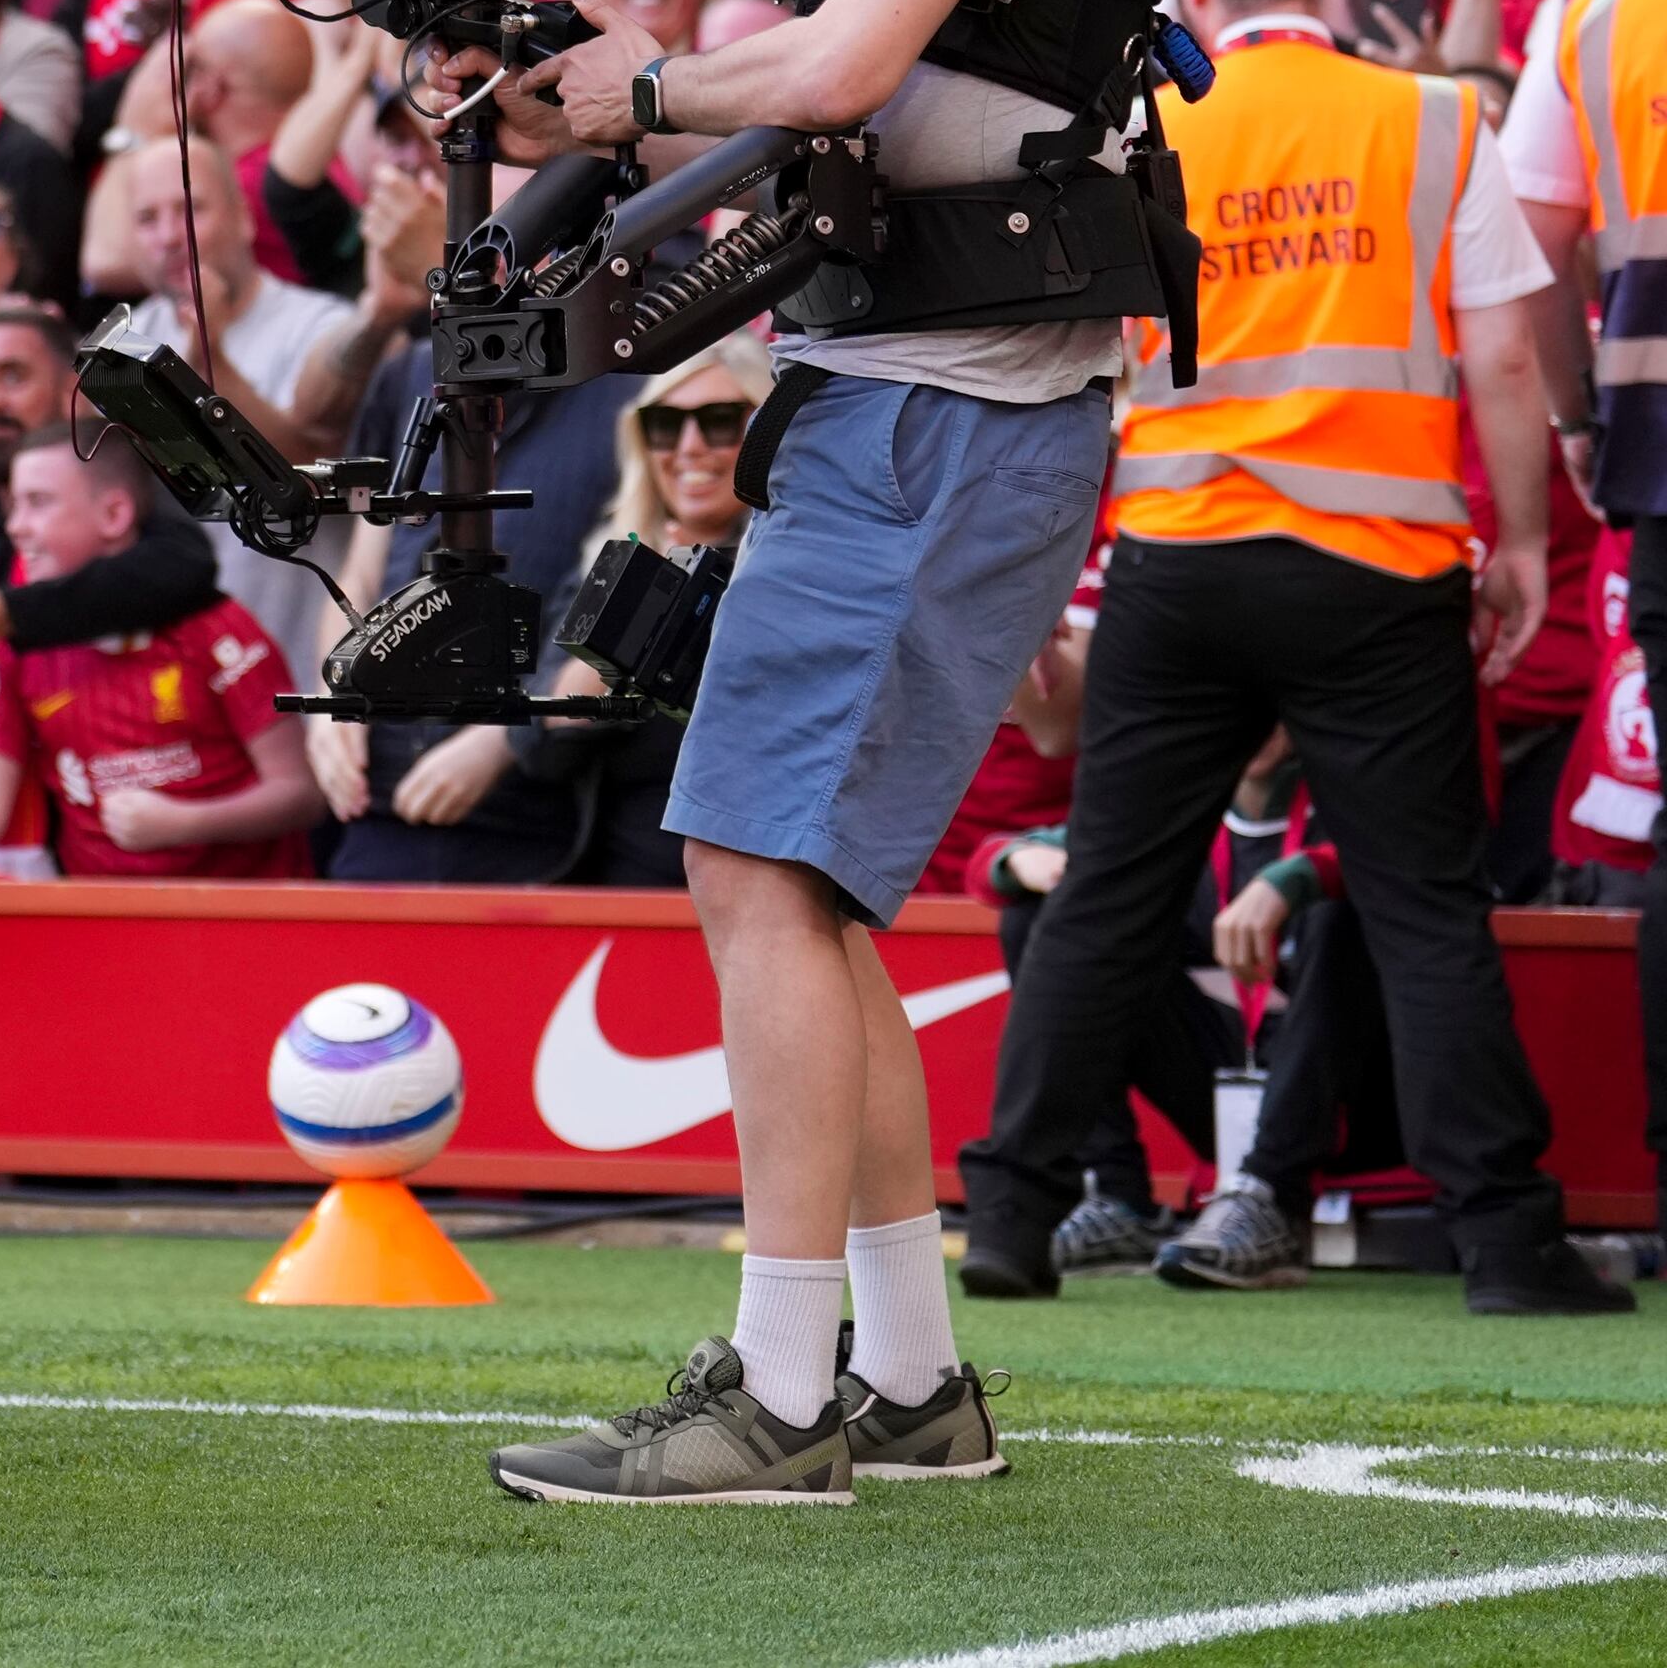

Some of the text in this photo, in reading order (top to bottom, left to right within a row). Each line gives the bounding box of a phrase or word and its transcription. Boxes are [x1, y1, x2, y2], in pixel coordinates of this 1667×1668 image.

[1218, 179, 1354, 230] CROWD
[746, 262, 772, 283] G-70x
[1202, 226, 1376, 282] STEWARD
[370, 589, 452, 663] STEADICAM
